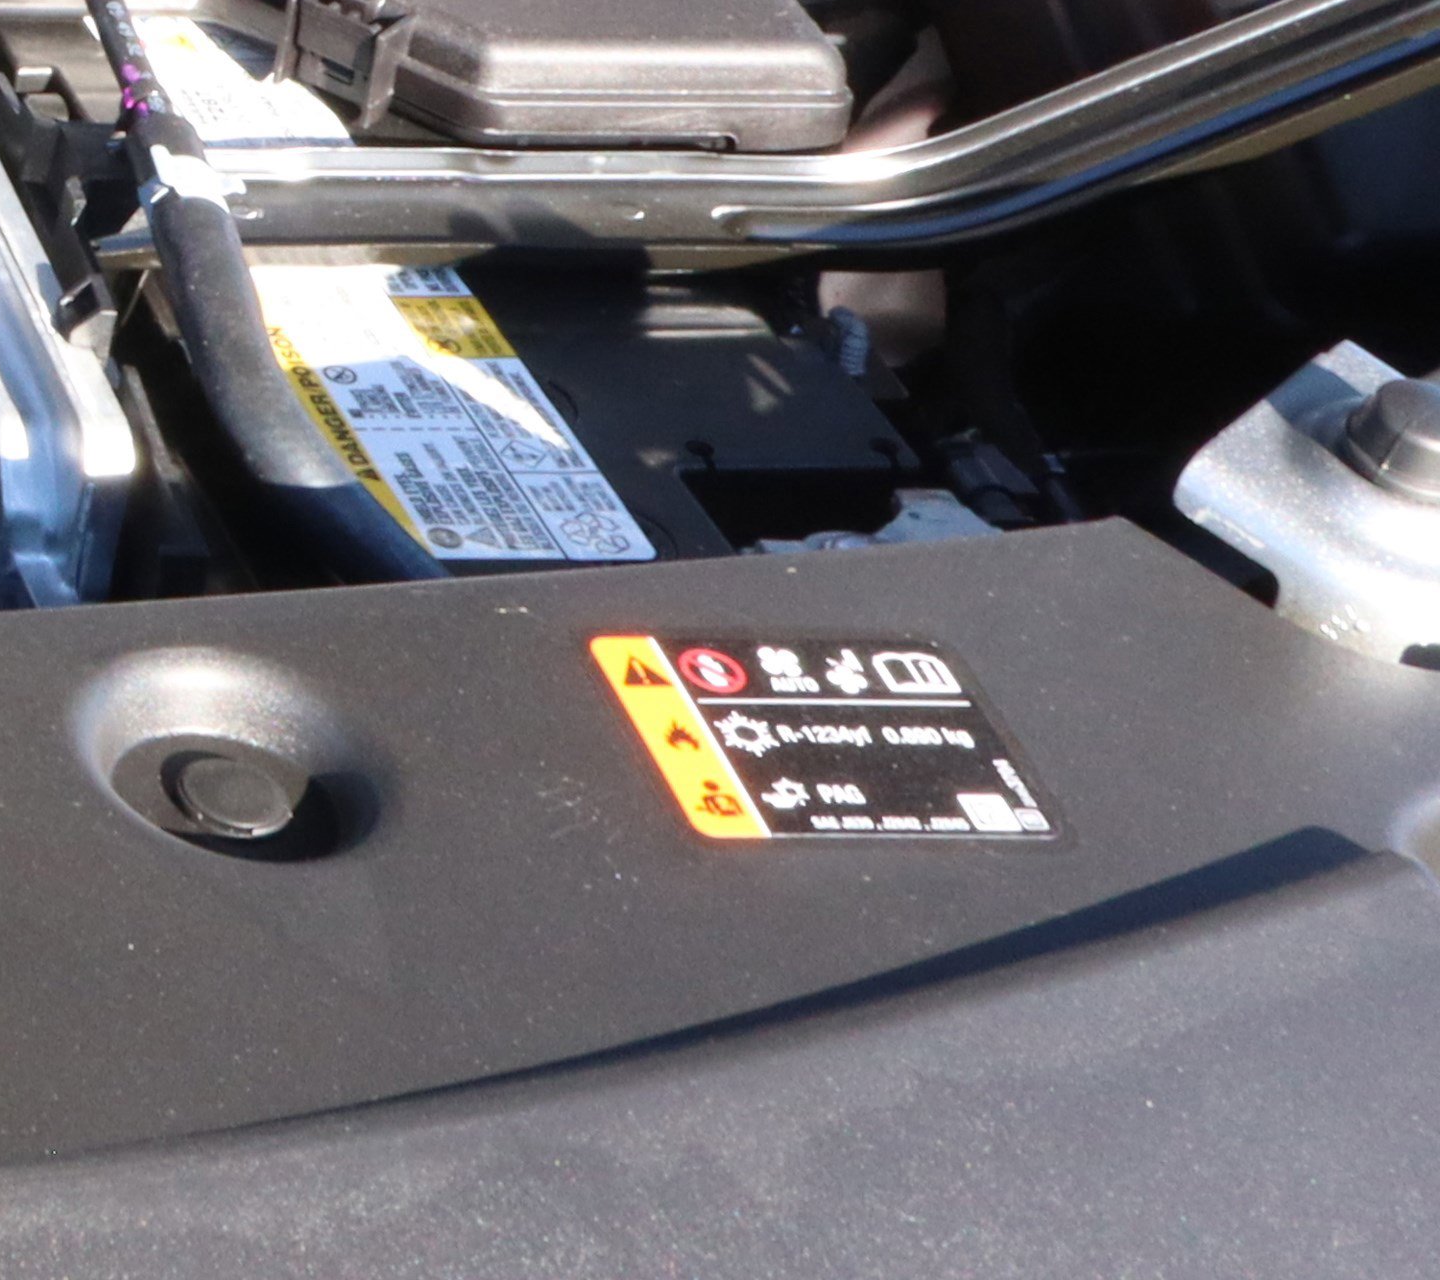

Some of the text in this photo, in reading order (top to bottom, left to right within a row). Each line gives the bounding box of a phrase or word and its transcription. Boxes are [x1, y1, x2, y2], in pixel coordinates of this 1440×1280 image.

[771, 676, 820, 694] AUTO
[776, 724, 873, 748] R-1234yf
[942, 727, 976, 750] kg
[816, 784, 866, 805] PAG
